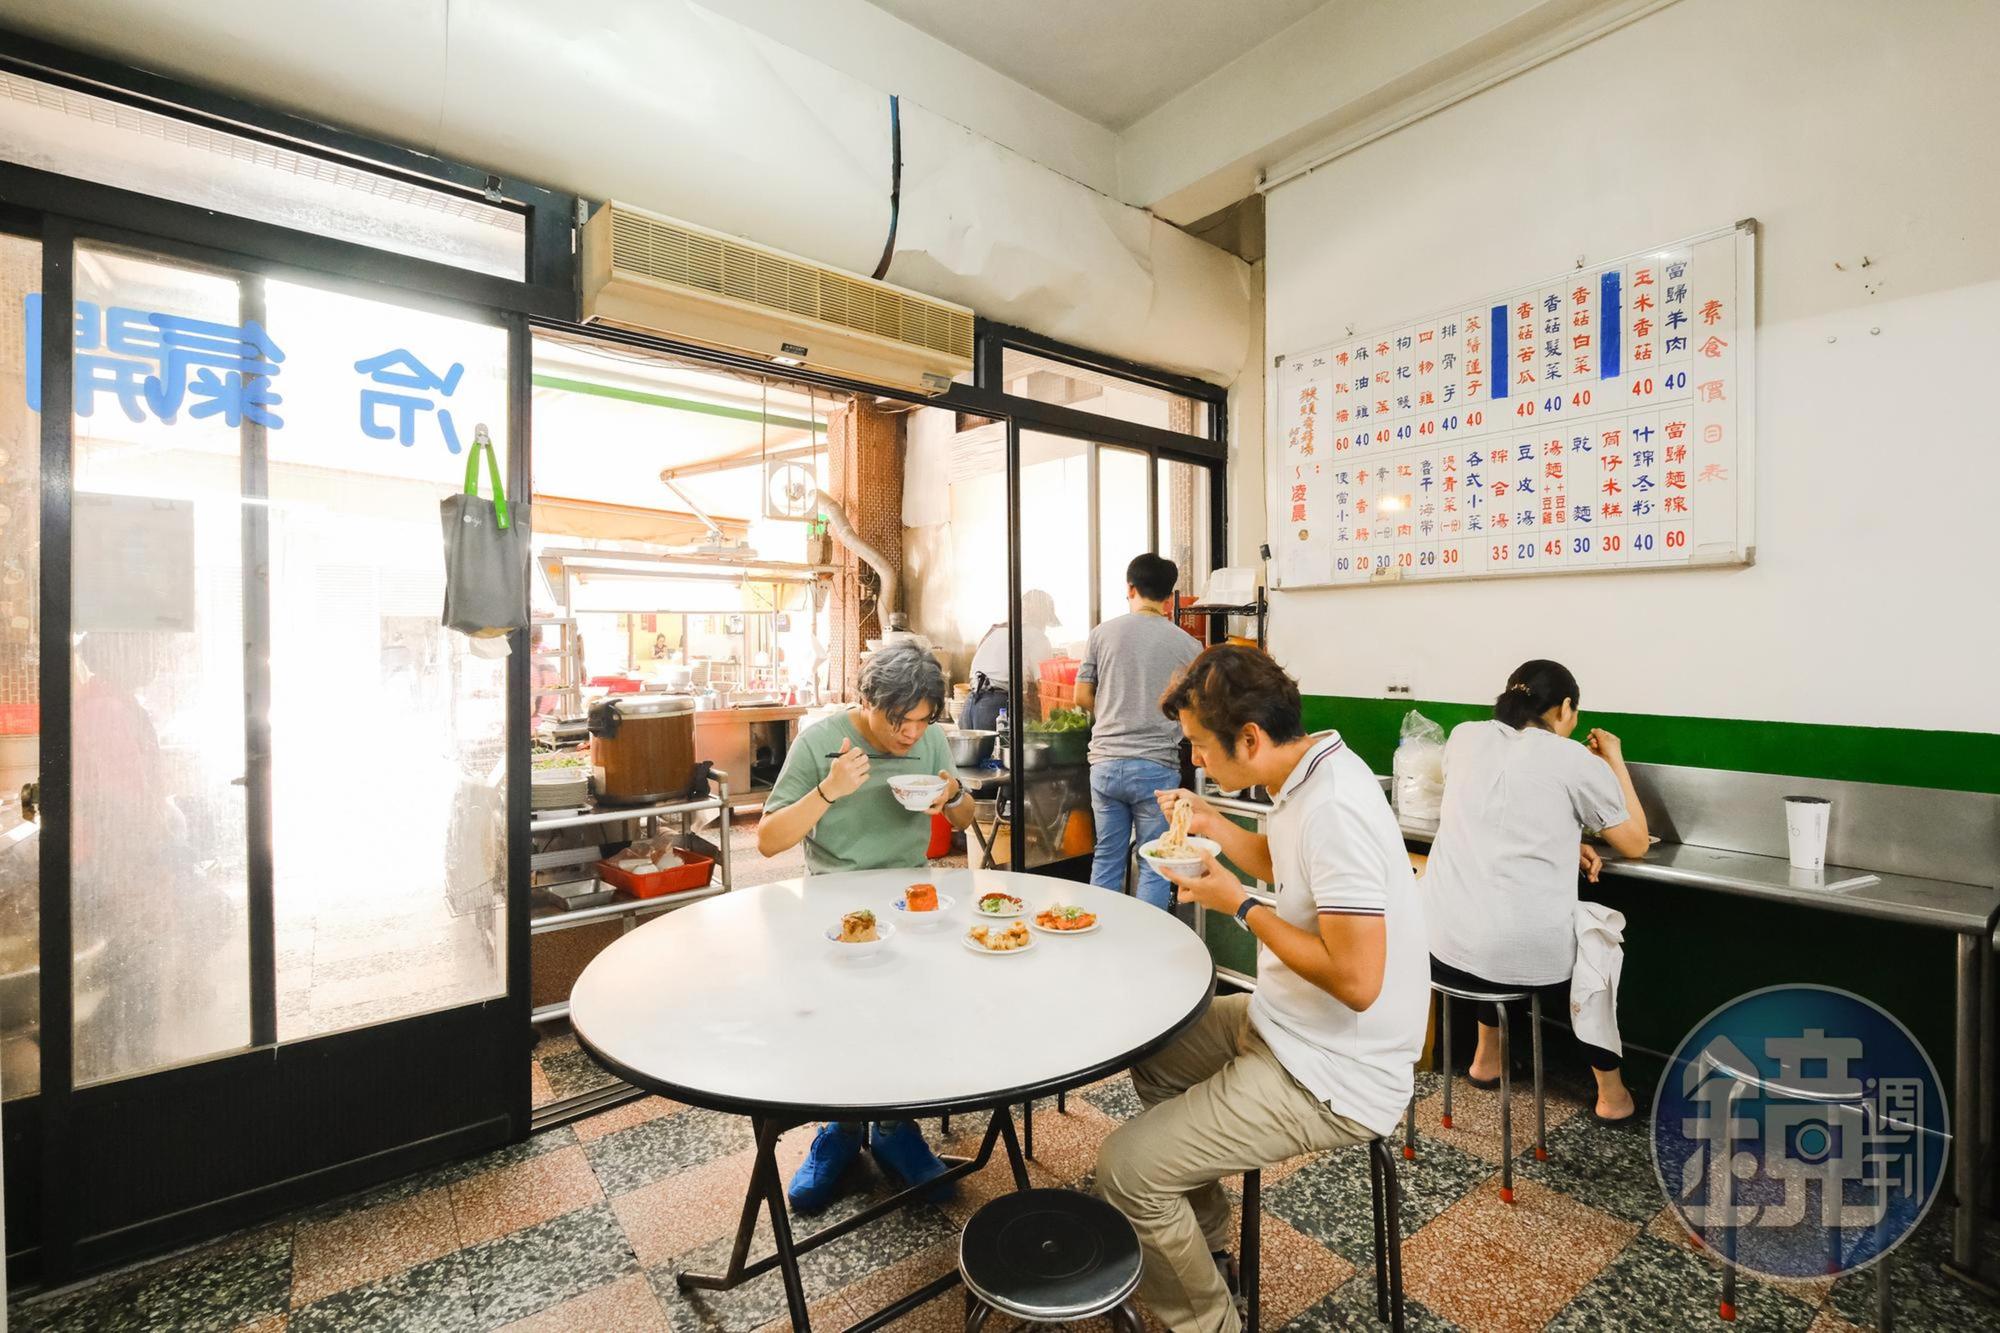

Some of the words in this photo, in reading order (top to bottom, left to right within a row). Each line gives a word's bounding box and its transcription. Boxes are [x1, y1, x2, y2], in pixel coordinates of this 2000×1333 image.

[1633, 269, 1654, 361] 玉米香菇
[1665, 261, 1688, 354] 當歸羊肉
[1572, 286, 1591, 375] 香菇白菜
[1517, 302, 1535, 385] 香菇苦瓜
[1354, 347, 1369, 420] 麻油雞
[1632, 378, 1653, 396] 40
[1665, 371, 1686, 390] 40
[1572, 390, 1591, 407] 40
[1697, 299, 1729, 482] 素食價目表
[1517, 401, 1535, 417] 40
[1544, 395, 1562, 412] 40
[1442, 415, 1458, 431] 40
[1466, 411, 1482, 427] 40
[1376, 429, 1390, 443] 40
[1396, 425, 1411, 440] 40
[1418, 421, 1434, 436] 40
[1336, 437, 1349, 451] 60
[1355, 433, 1369, 447] 40
[1544, 440, 1563, 479] 湯麵
[1664, 421, 1688, 514] 當歸麵線
[1571, 436, 1592, 523] 乾麵
[1601, 430, 1623, 520] 筒仔米糕
[1632, 426, 1655, 517] 什錦冬粉
[1466, 451, 1483, 532] 各式小菜
[1490, 449, 1509, 529] 綜合湯
[1517, 444, 1536, 526] 豆皮湯
[1573, 537, 1590, 553] 30
[1602, 535, 1621, 552] 30
[1633, 534, 1654, 551] 40
[1666, 530, 1685, 548] 60
[1443, 549, 1459, 564] 30
[1492, 545, 1508, 561] 35
[1518, 543, 1535, 559] 20
[1545, 540, 1562, 556] 45
[1337, 557, 1349, 571] 60
[1357, 556, 1369, 570] 20
[1376, 555, 1390, 568] 30
[1398, 553, 1412, 567] 20
[1420, 551, 1435, 566] 20
